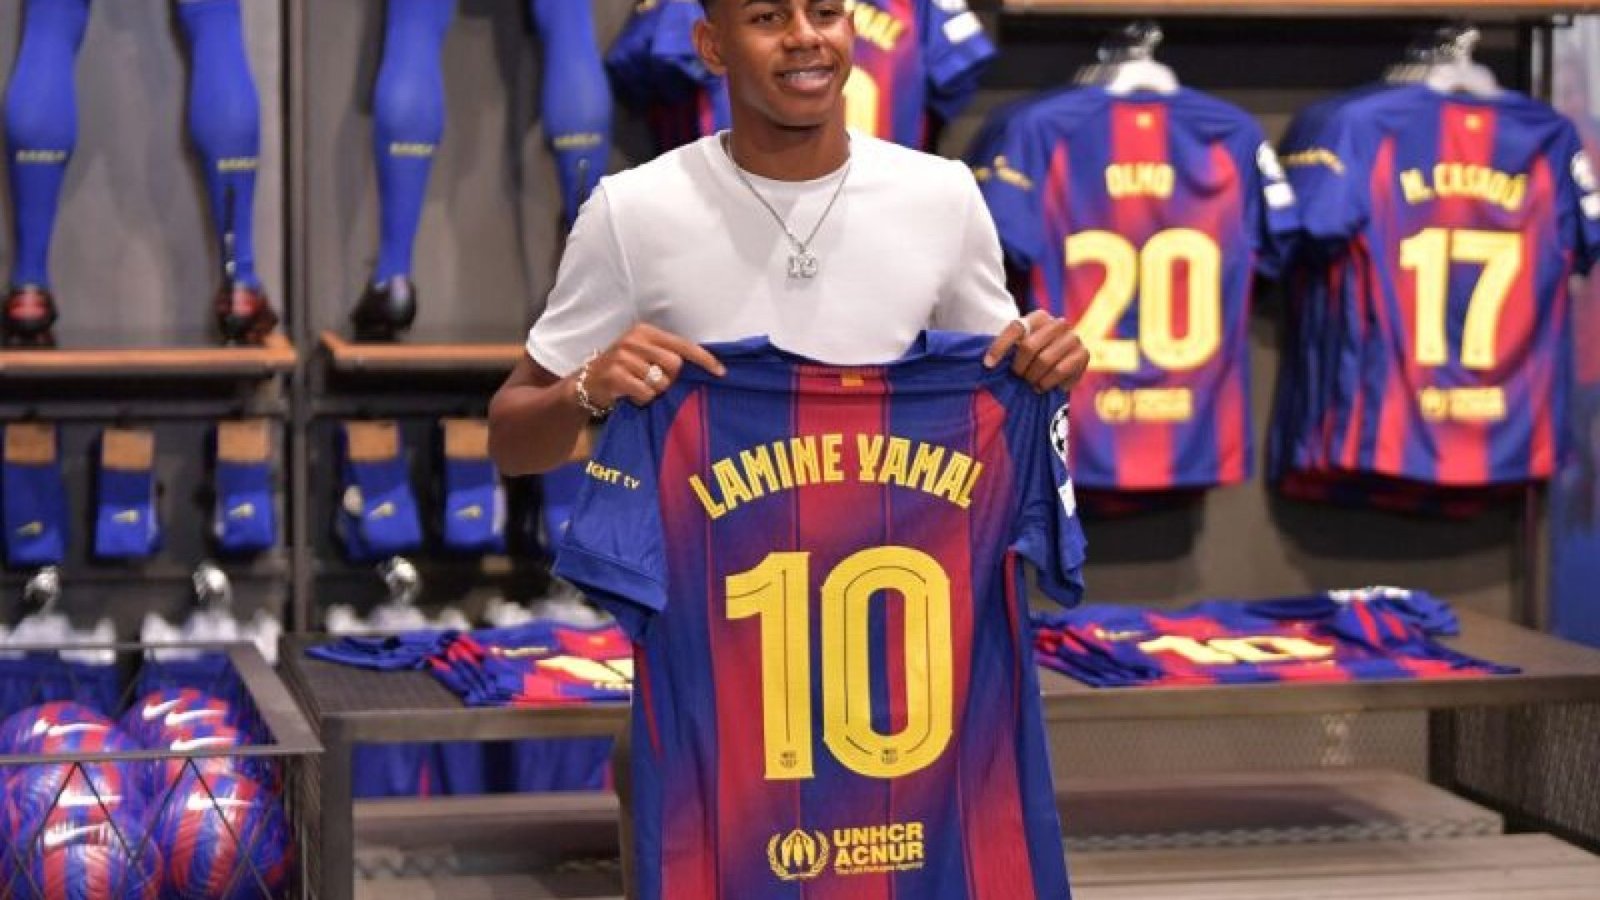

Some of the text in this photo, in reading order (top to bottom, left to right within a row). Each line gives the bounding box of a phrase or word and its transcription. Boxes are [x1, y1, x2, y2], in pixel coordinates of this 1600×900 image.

[1105, 163, 1175, 199] OLMO
[1065, 228, 1221, 372] 20
[1399, 227, 1524, 370] 17
[688, 433, 984, 519] LAMINE YAMAL
[725, 545, 954, 781] 10
[1137, 635, 1336, 665] 10
[833, 822, 924, 847] UNHCR
[834, 841, 925, 867] ACNUR
